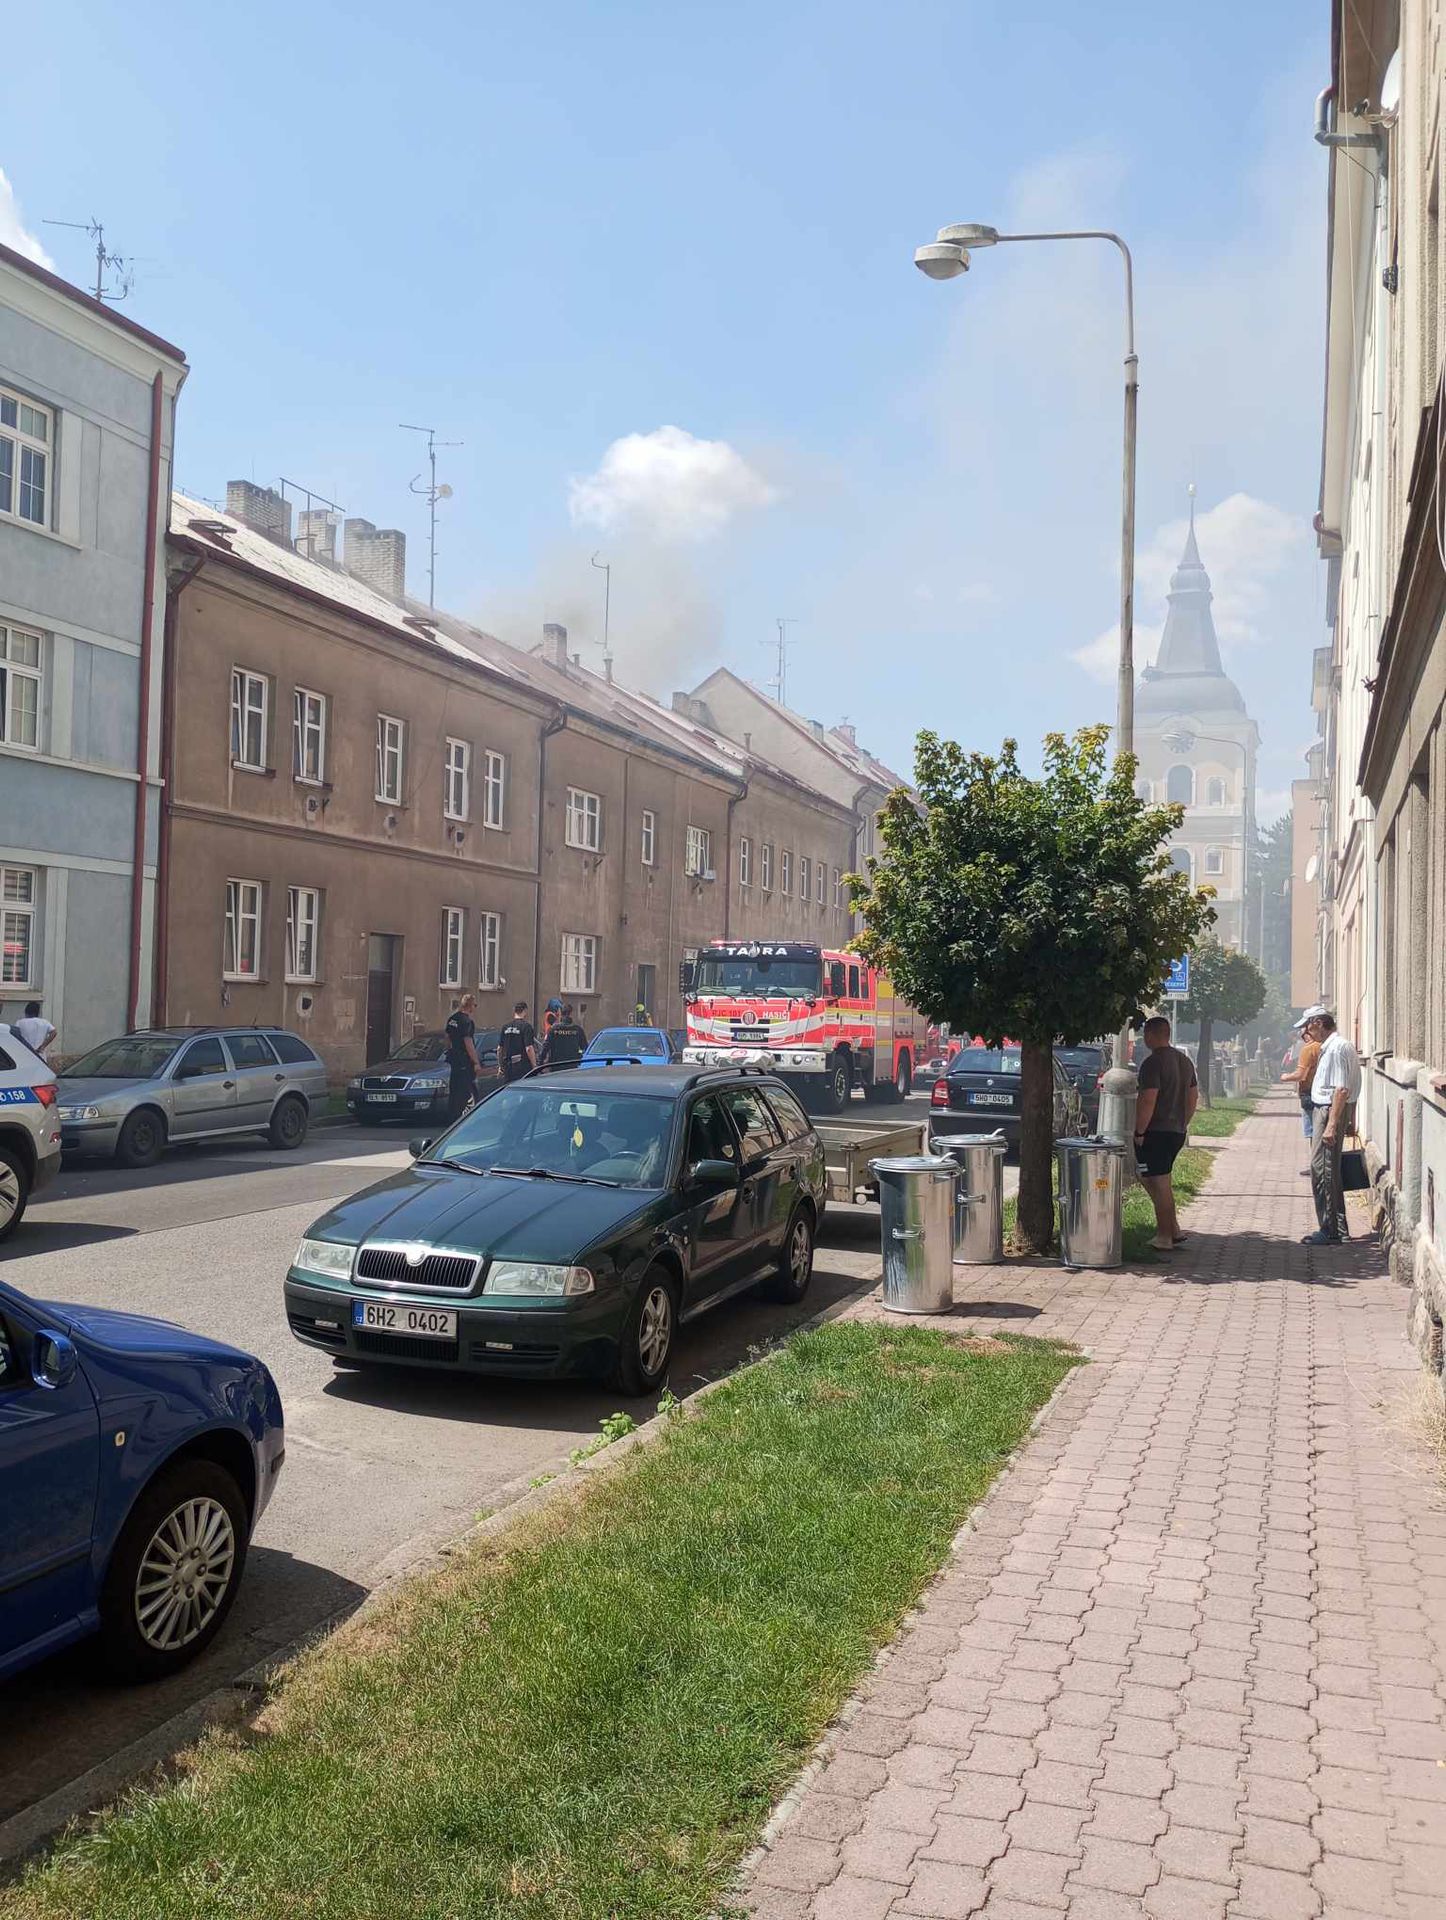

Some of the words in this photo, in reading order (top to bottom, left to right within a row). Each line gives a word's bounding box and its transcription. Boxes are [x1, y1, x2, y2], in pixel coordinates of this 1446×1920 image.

[726, 946, 788, 956] TARA
[7, 1090, 25, 1100] 158
[367, 1306, 396, 1327] 6H2
[408, 1311, 449, 1333] 0402
